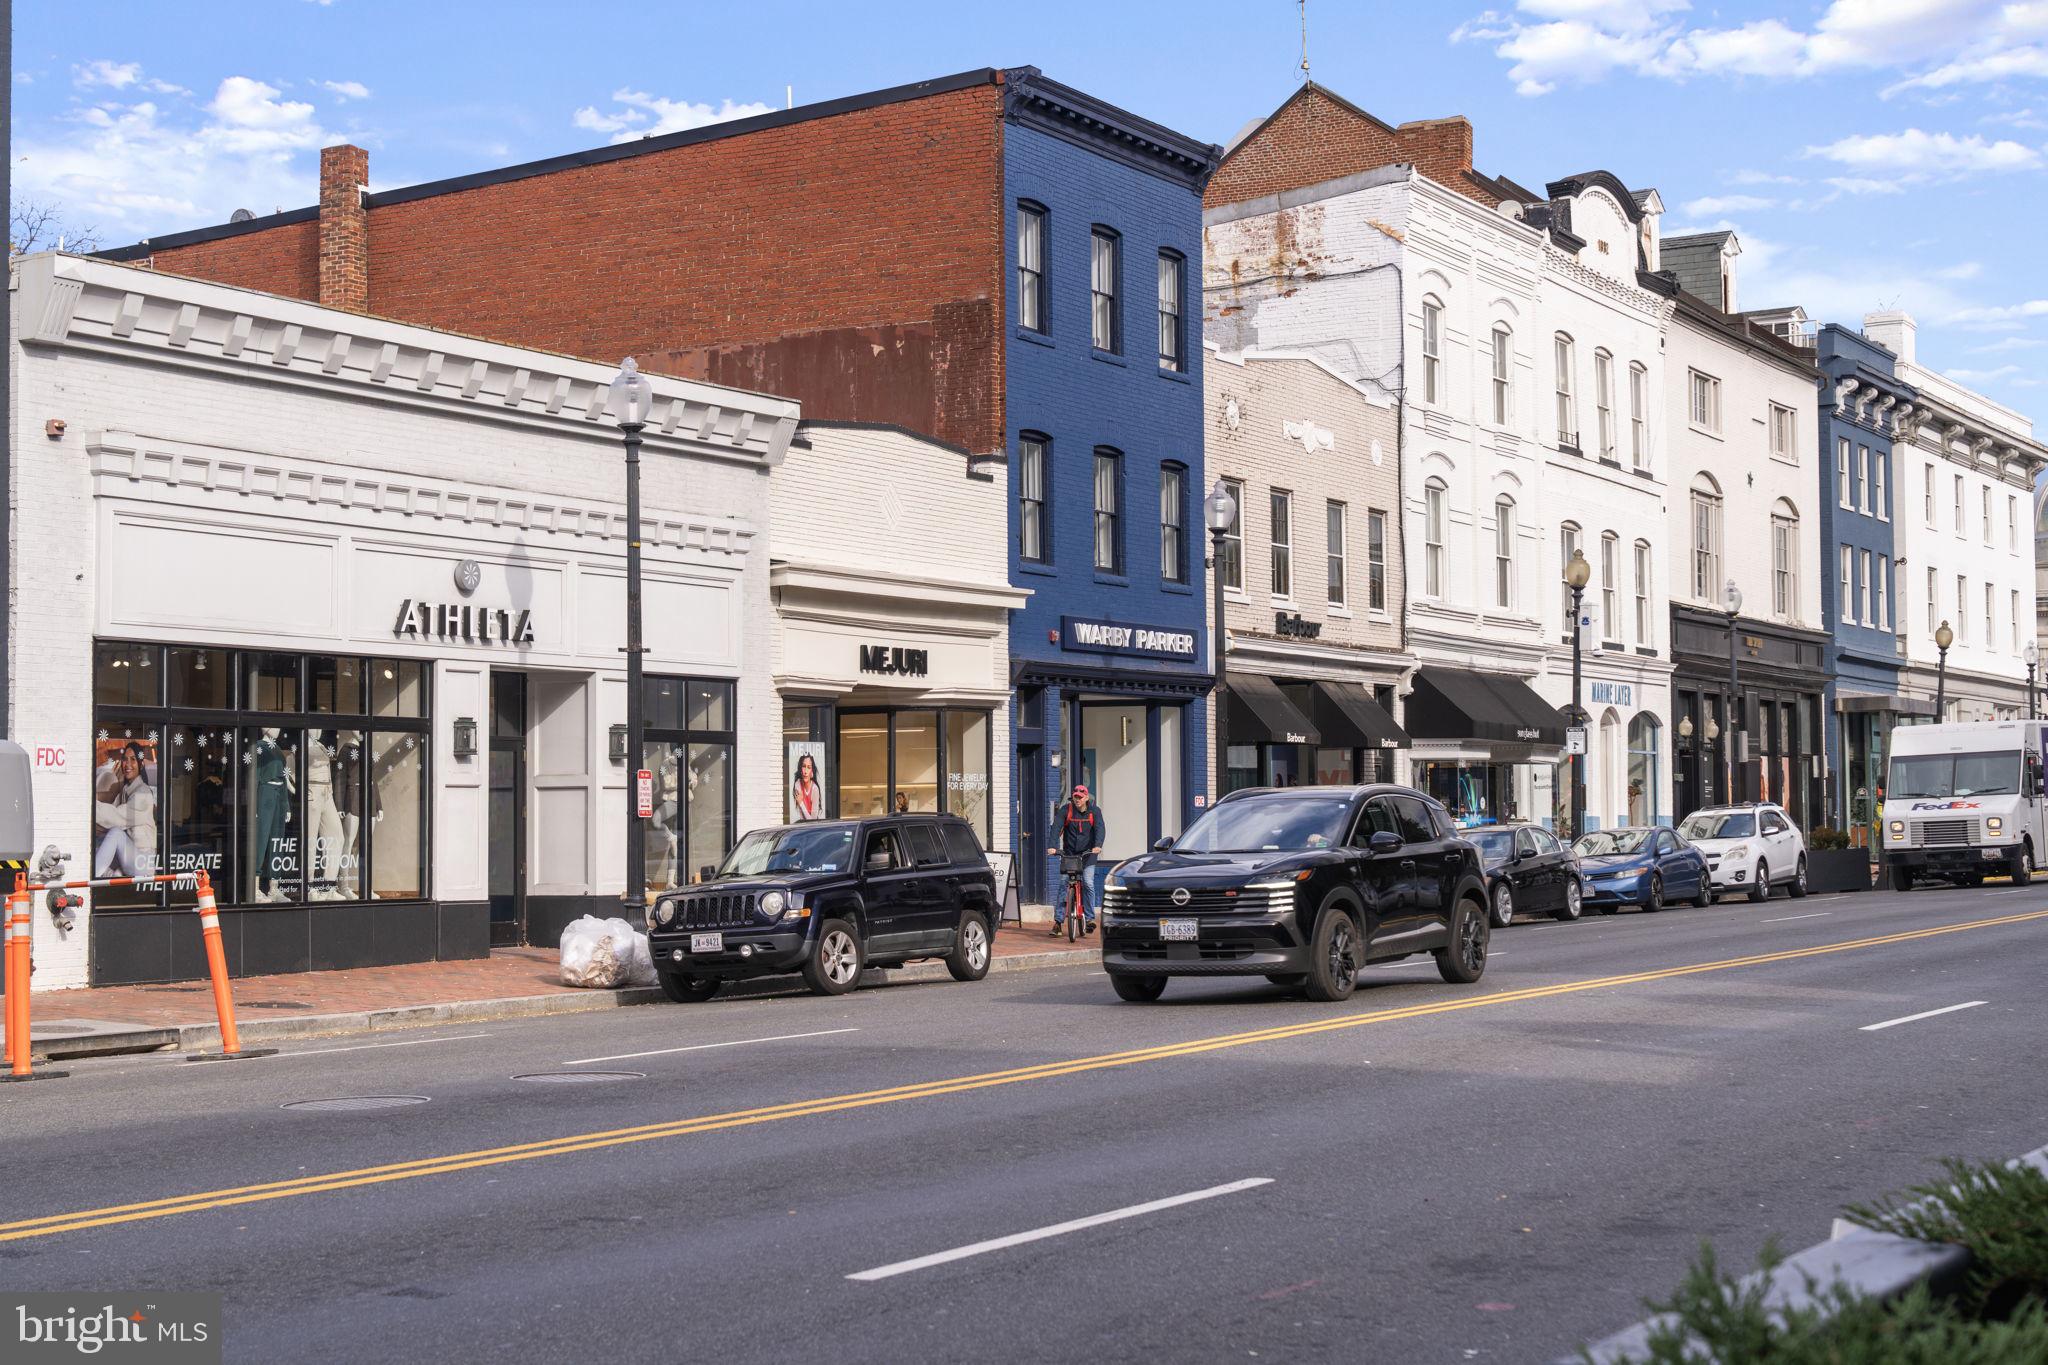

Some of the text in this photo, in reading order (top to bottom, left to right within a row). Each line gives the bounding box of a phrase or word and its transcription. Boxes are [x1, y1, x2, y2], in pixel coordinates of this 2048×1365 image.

[394, 599, 534, 642] ATHLETA
[1275, 611, 1322, 638] Barbour
[1074, 622, 1194, 654] WARBY PARKER
[859, 644, 928, 675] MEJURI
[1591, 681, 1632, 707] MARINE LAYER
[1286, 732, 1306, 743] Barbour
[1381, 738, 1399, 748] Barbour
[37, 747, 65, 766] FDC
[789, 743, 825, 757] MEJURI
[948, 773, 987, 782] FINE JEWELRY
[947, 781, 988, 791] FOR EVERY DAY
[1911, 801, 1981, 812] FedEx
[271, 838, 297, 853] THE
[134, 853, 222, 871] CELEBRATE
[705, 937, 719, 947] 9421
